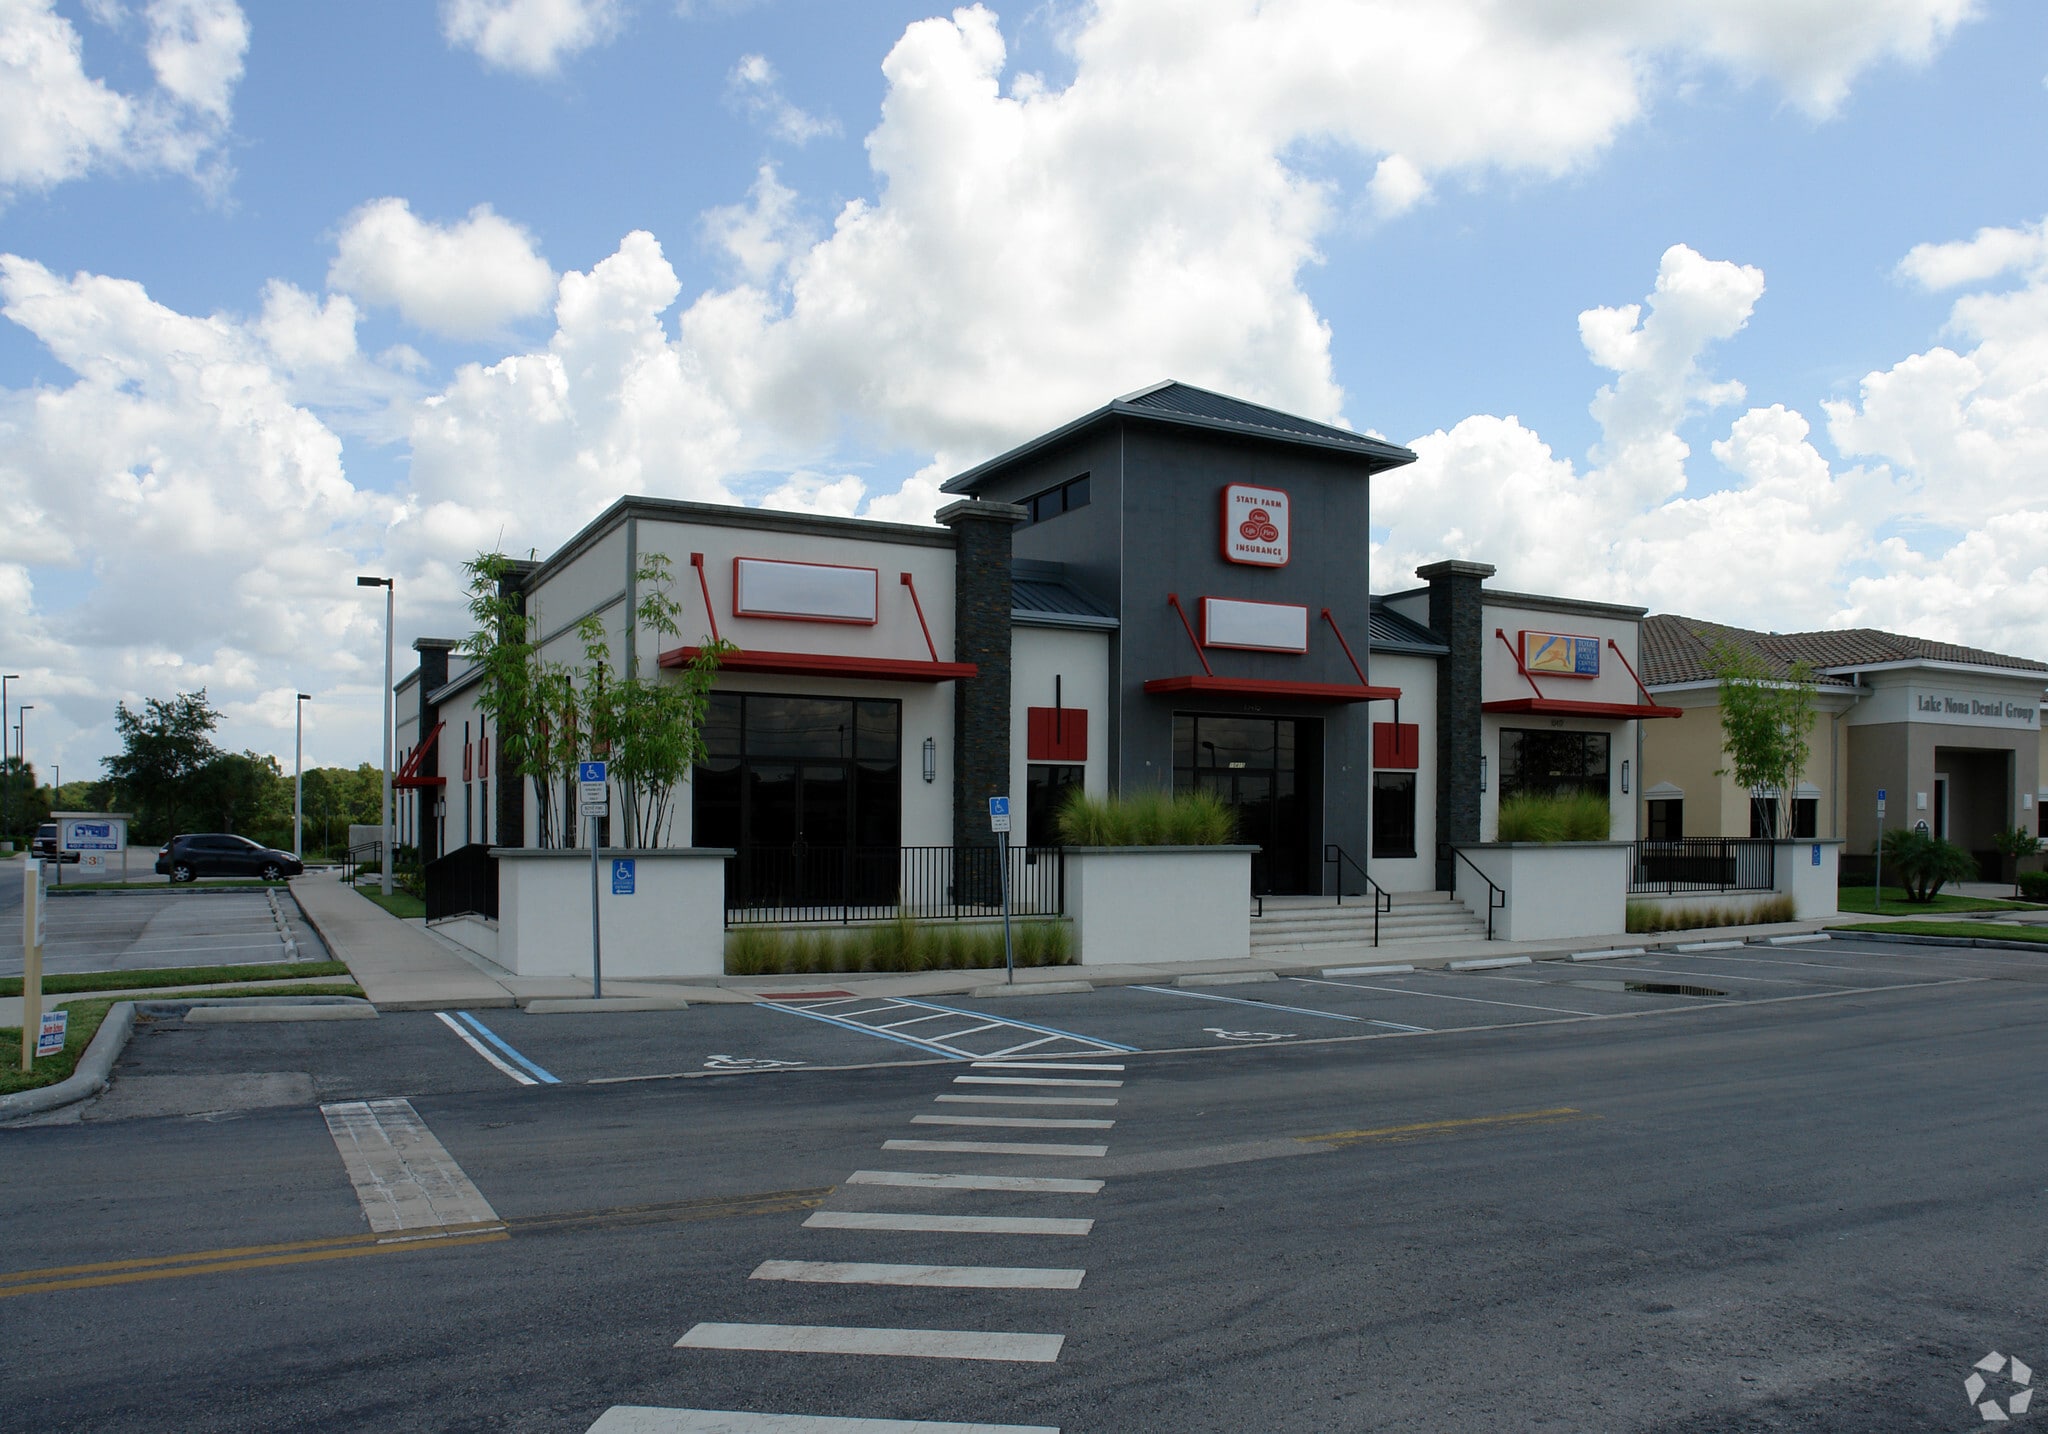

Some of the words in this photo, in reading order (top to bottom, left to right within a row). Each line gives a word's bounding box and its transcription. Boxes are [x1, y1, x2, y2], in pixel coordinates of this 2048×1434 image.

[1236, 495, 1258, 504] STATE
[1261, 499, 1282, 508] FARM
[1236, 543, 1282, 556] INSURANCE
[1918, 695, 1942, 712] Lake
[1944, 697, 1970, 714] Nona
[1971, 700, 2003, 716] Dental
[2005, 703, 2034, 723] Group
